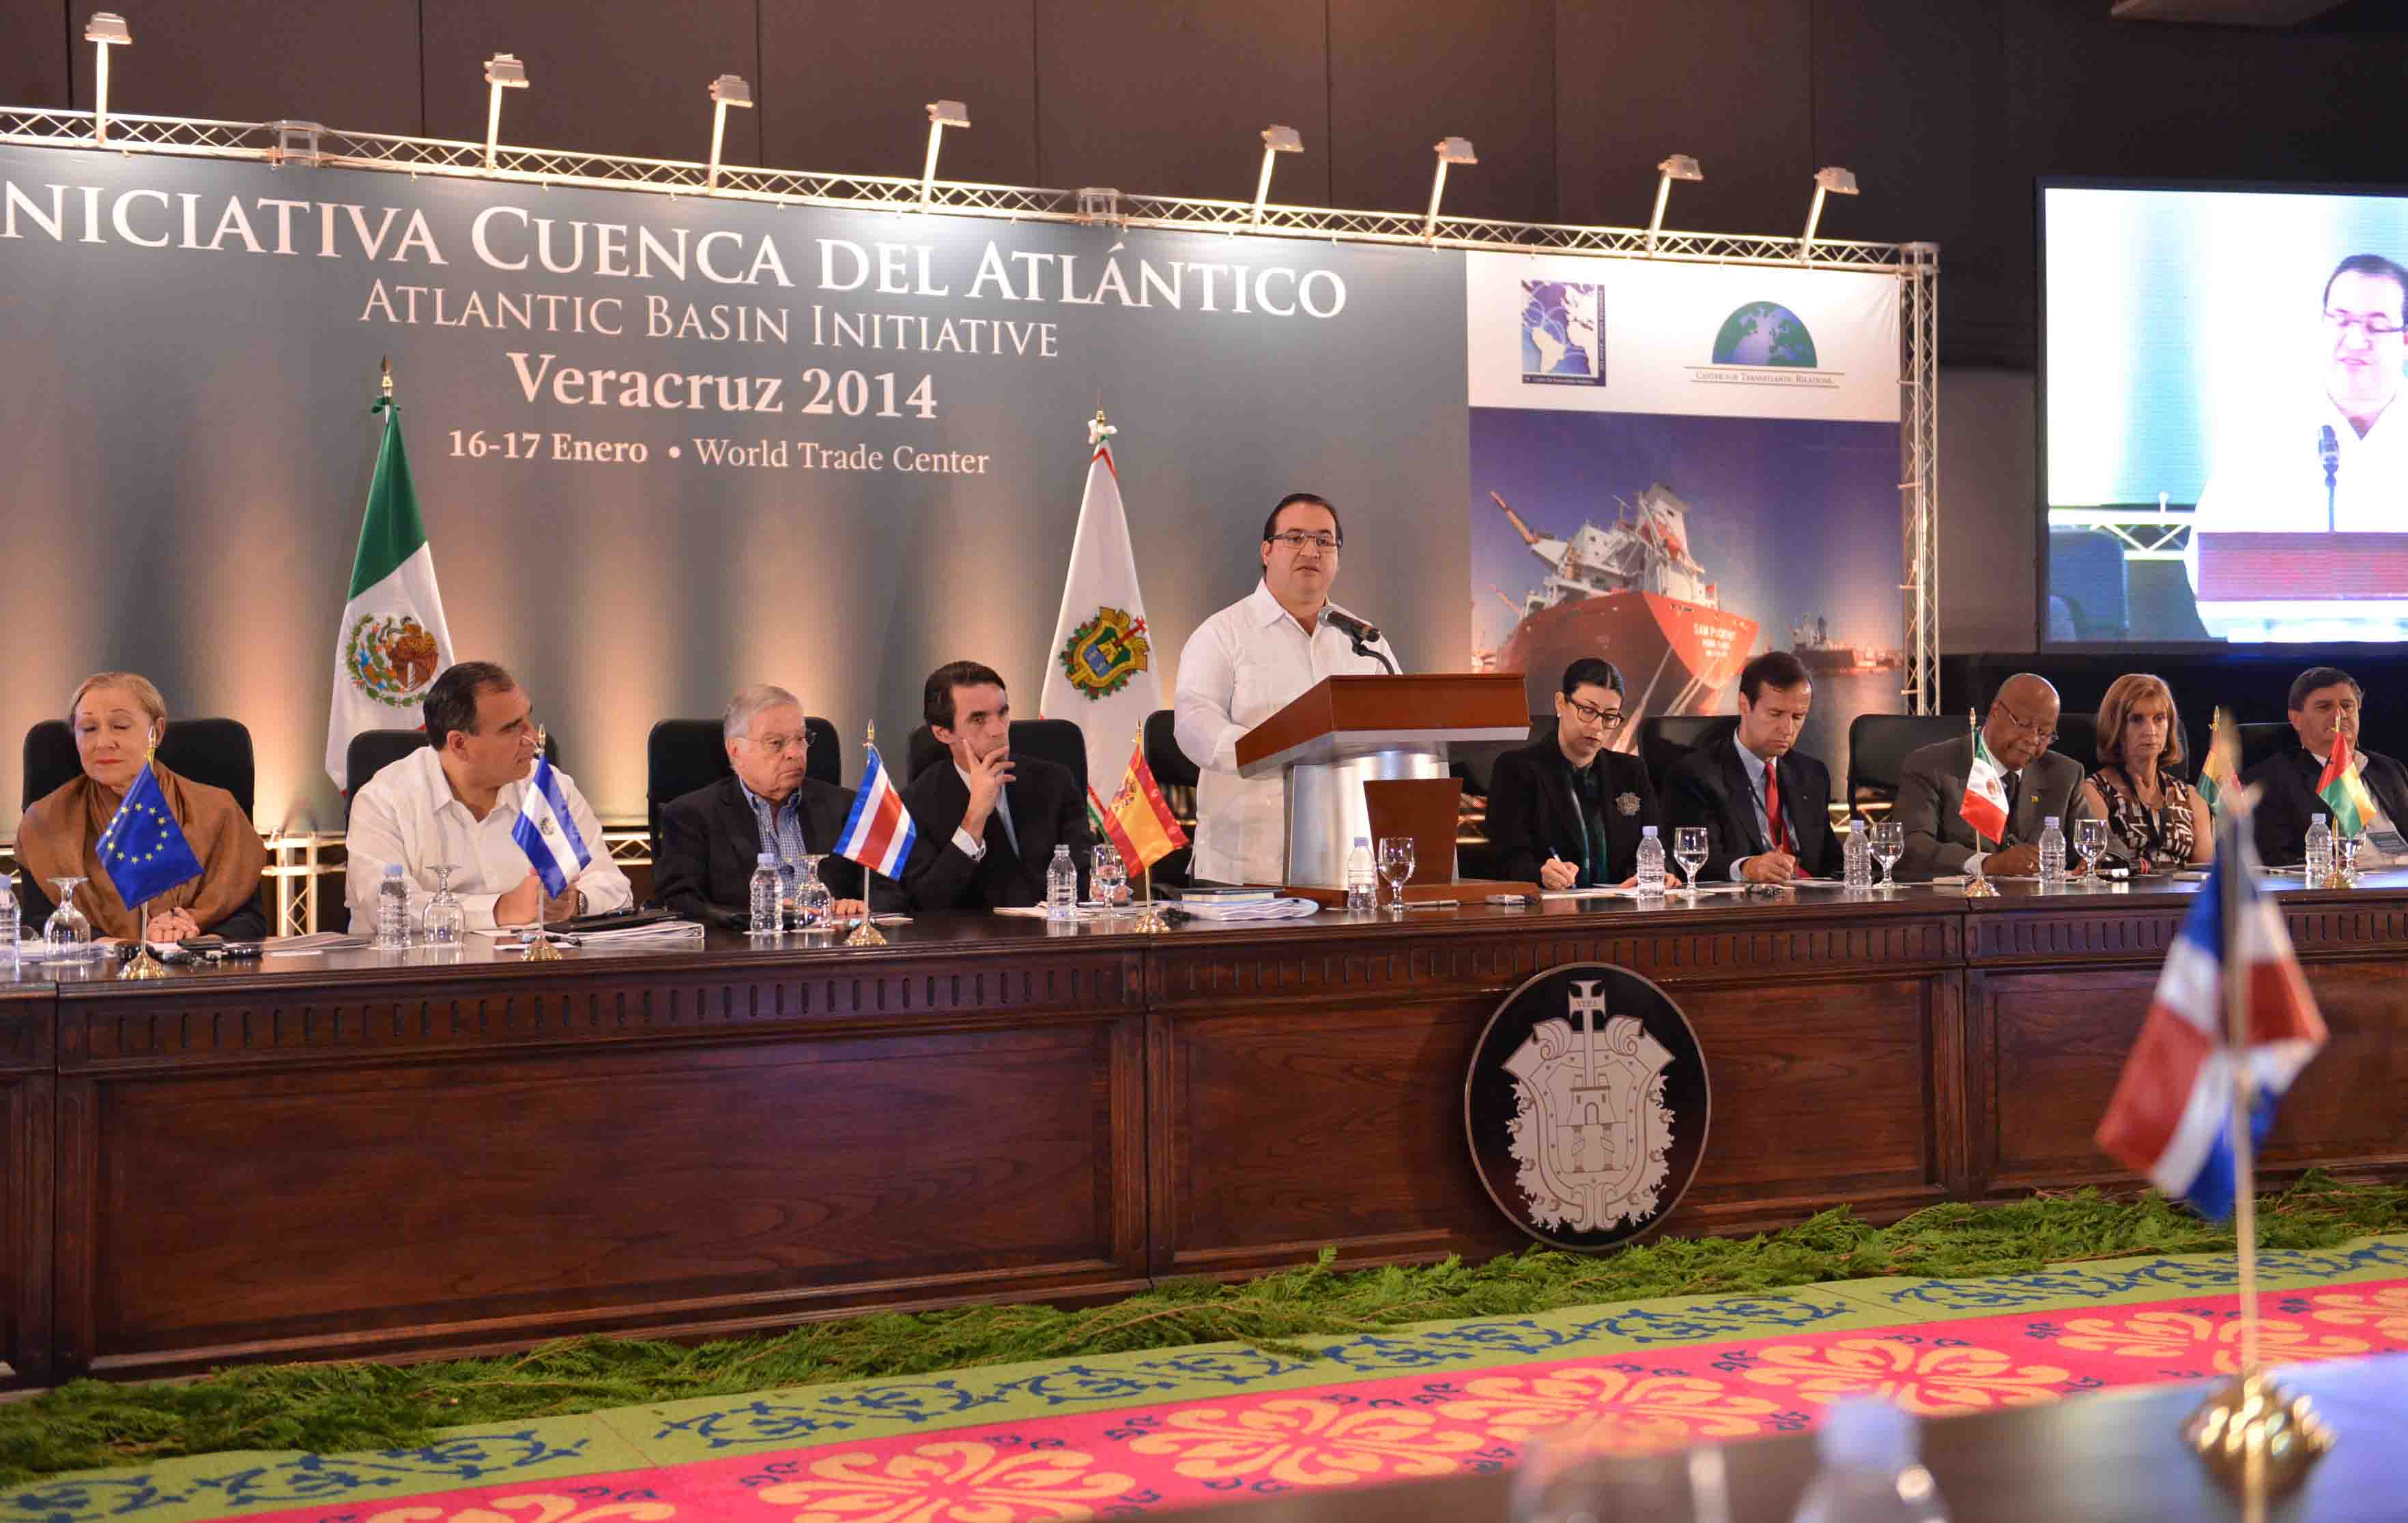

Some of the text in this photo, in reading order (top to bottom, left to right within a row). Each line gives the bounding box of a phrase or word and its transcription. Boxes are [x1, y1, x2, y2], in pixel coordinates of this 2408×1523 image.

[472, 205, 796, 287] CUENCA
[815, 238, 949, 296] DEL
[964, 241, 1347, 319] ATLÁNTICO
[358, 278, 1058, 358] ATLANTIC BASIN INITIATIVE
[505, 352, 938, 419] Veracruz 2014
[449, 430, 990, 474] 16-17 Enero World Trade Center
